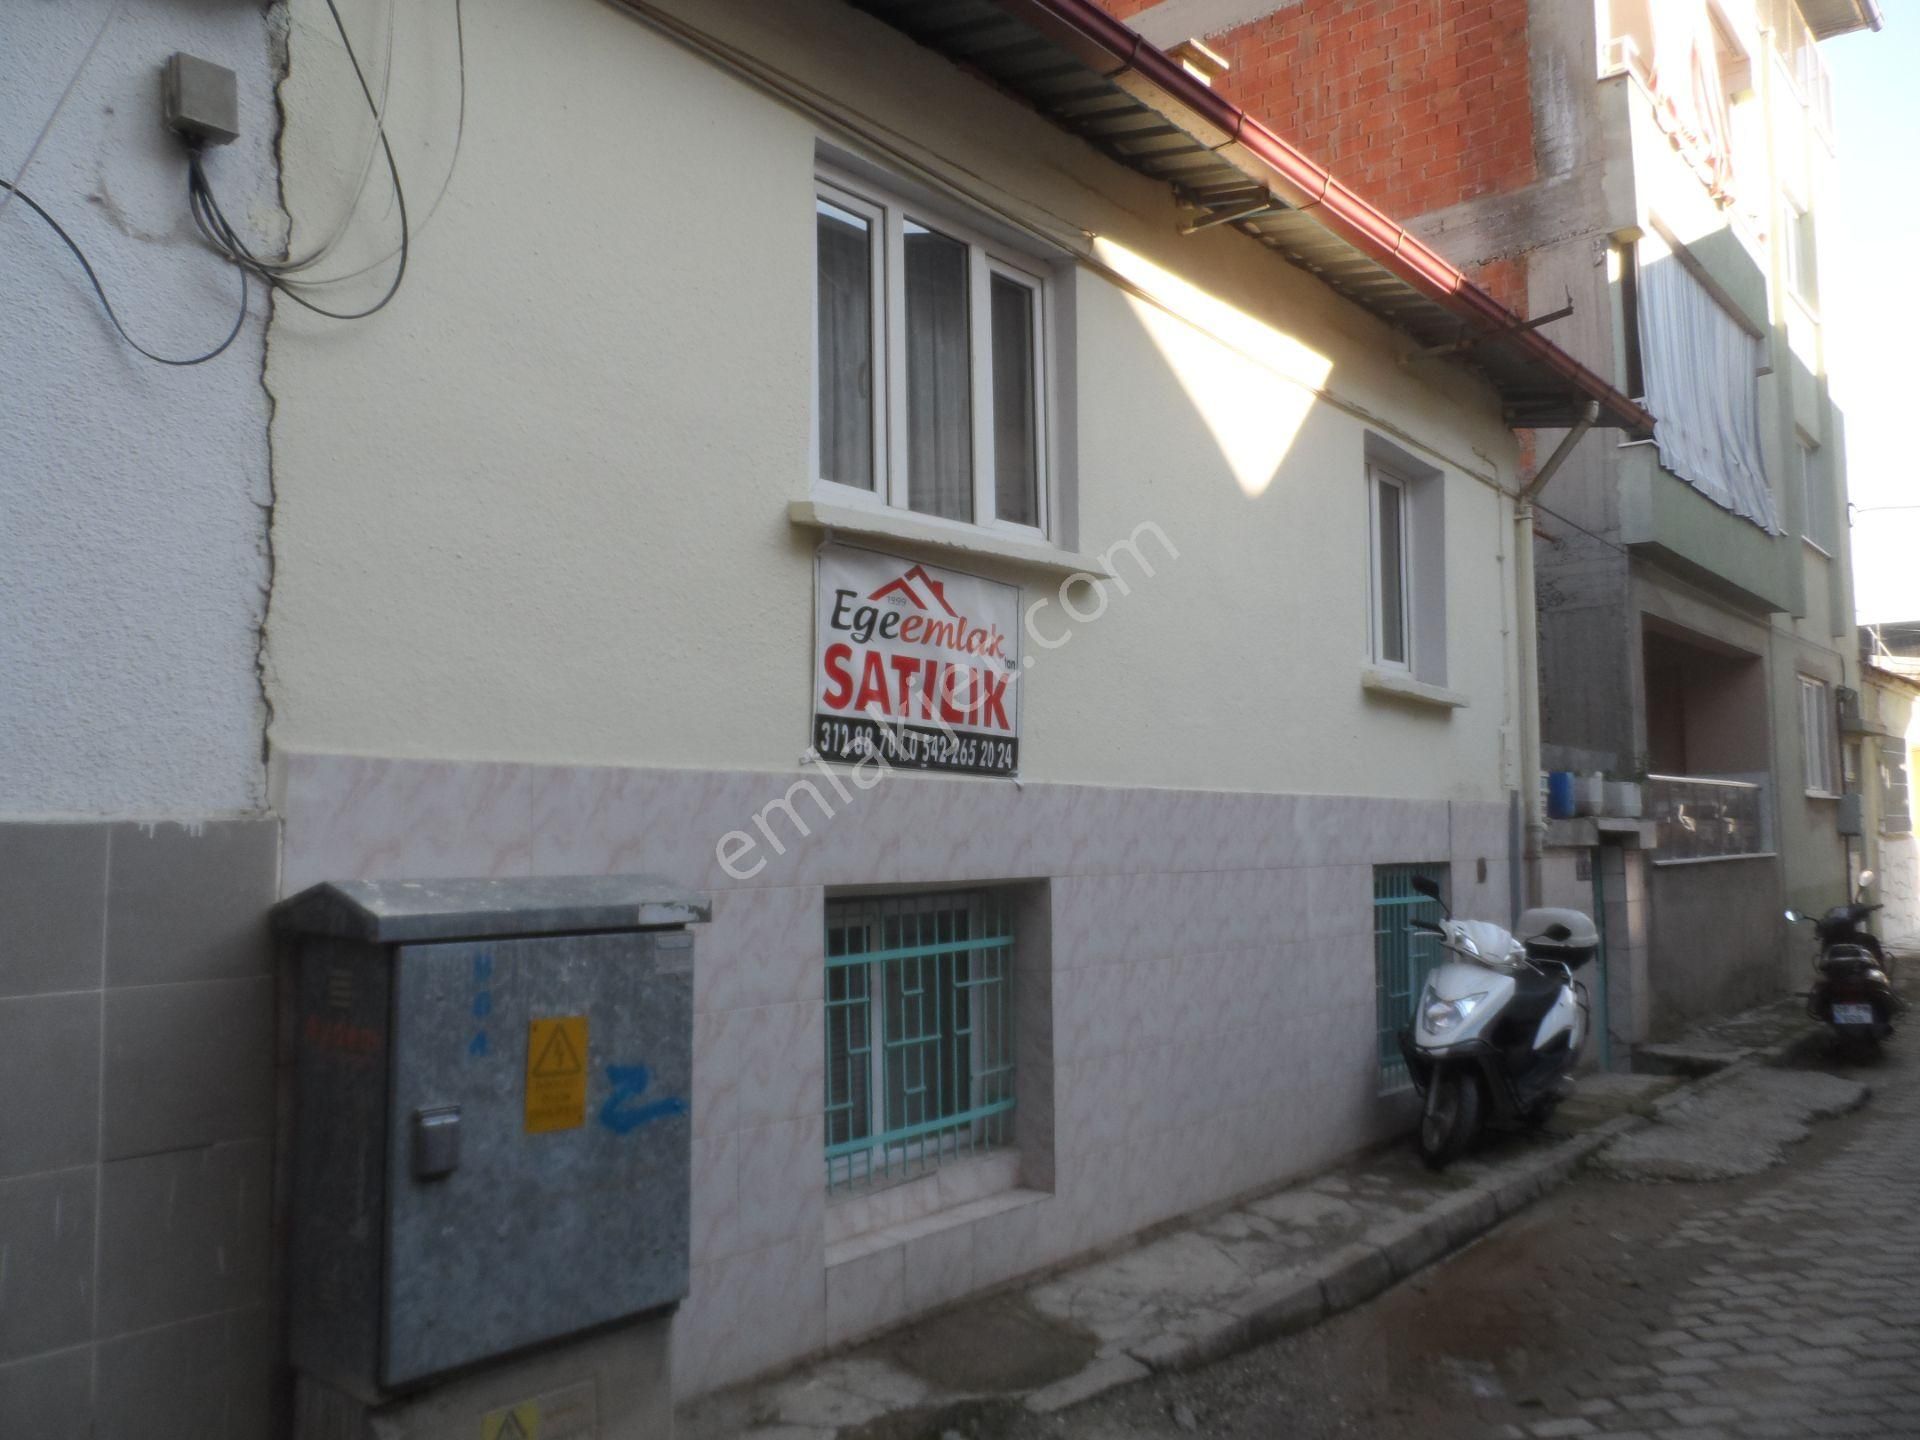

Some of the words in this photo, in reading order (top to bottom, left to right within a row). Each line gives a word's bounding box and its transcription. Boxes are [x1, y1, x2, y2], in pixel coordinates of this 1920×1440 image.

[822, 642, 1011, 732] SATILIK
[980, 740, 995, 768] 20
[997, 742, 1013, 769] 24
